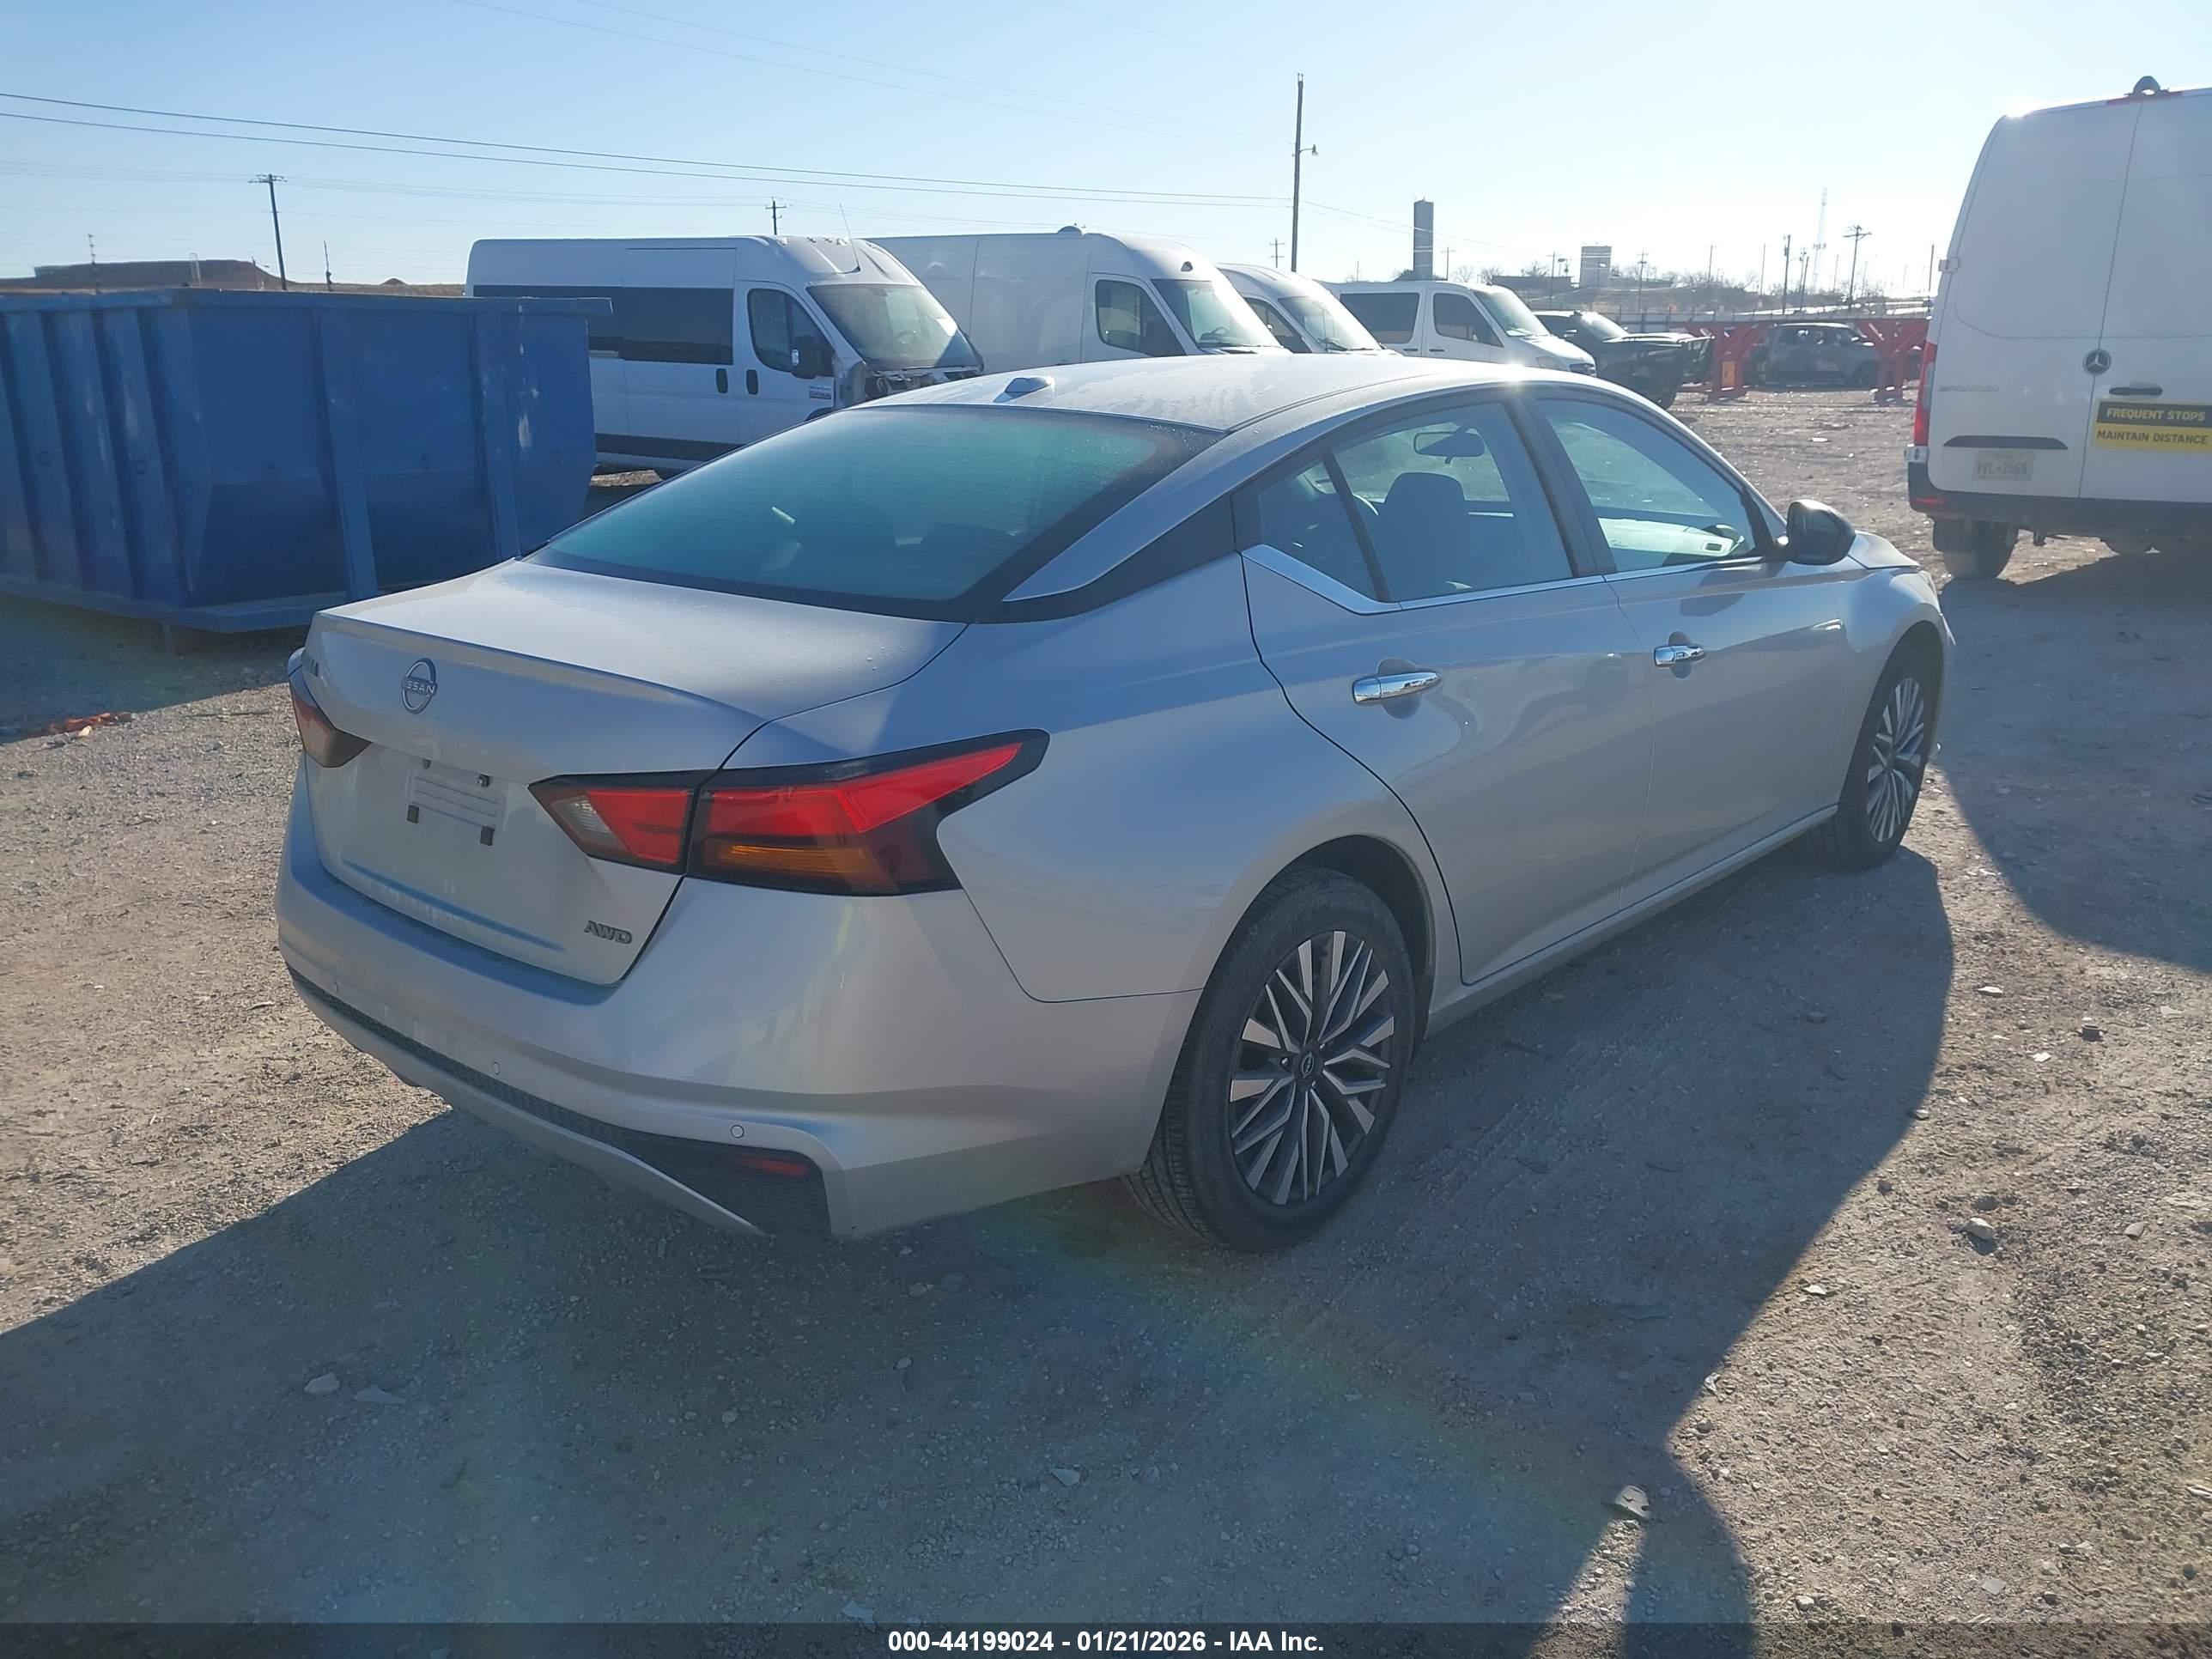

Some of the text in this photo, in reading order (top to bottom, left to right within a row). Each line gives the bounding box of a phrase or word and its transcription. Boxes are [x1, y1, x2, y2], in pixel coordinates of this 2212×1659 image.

[2106, 408, 2206, 422] FREQUENT STOPS
[2096, 429, 2209, 445] MAINTAIN DISTANCE
[402, 678, 435, 694] SSAN
[583, 920, 633, 945] AWD
